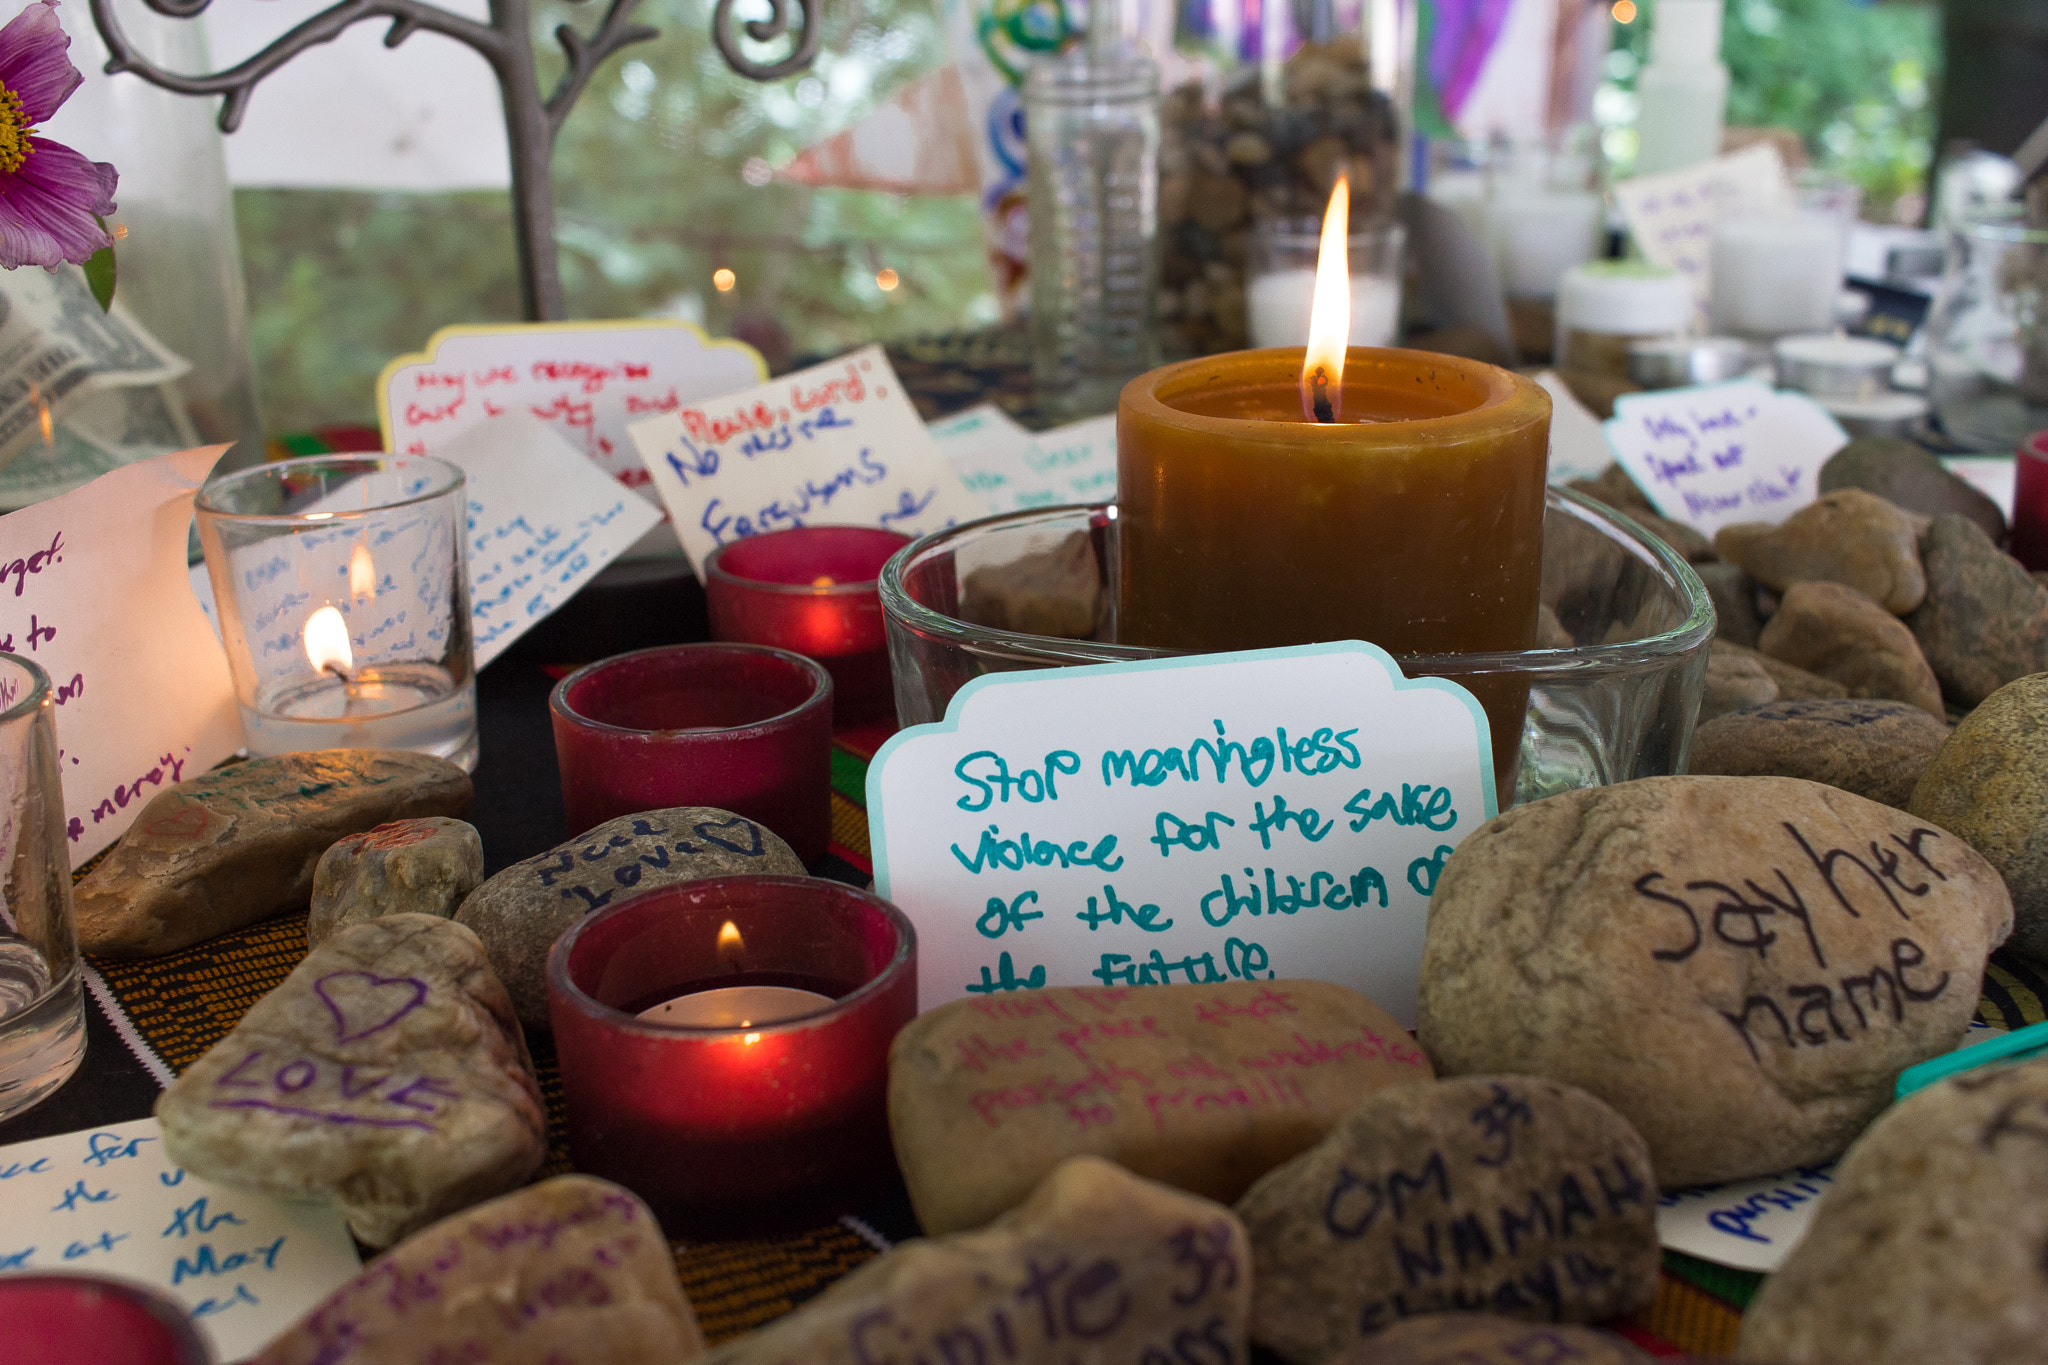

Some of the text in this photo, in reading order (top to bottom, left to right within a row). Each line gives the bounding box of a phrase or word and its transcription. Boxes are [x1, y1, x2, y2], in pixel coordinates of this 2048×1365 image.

[665, 436, 720, 487] No
[26, 614, 57, 652] to
[955, 719, 1361, 812] Stop meaningless
[1151, 812, 1235, 857] for
[1249, 795, 1334, 850] the
[1344, 783, 1457, 832] sake
[976, 891, 1043, 938] of
[1076, 885, 1173, 932] the
[1201, 867, 1388, 927] children
[1634, 822, 1948, 970] Say her
[966, 952, 1045, 994] the
[1720, 936, 1951, 1062] name
[216, 1050, 463, 1112] LOVE
[51, 1180, 121, 1213] the
